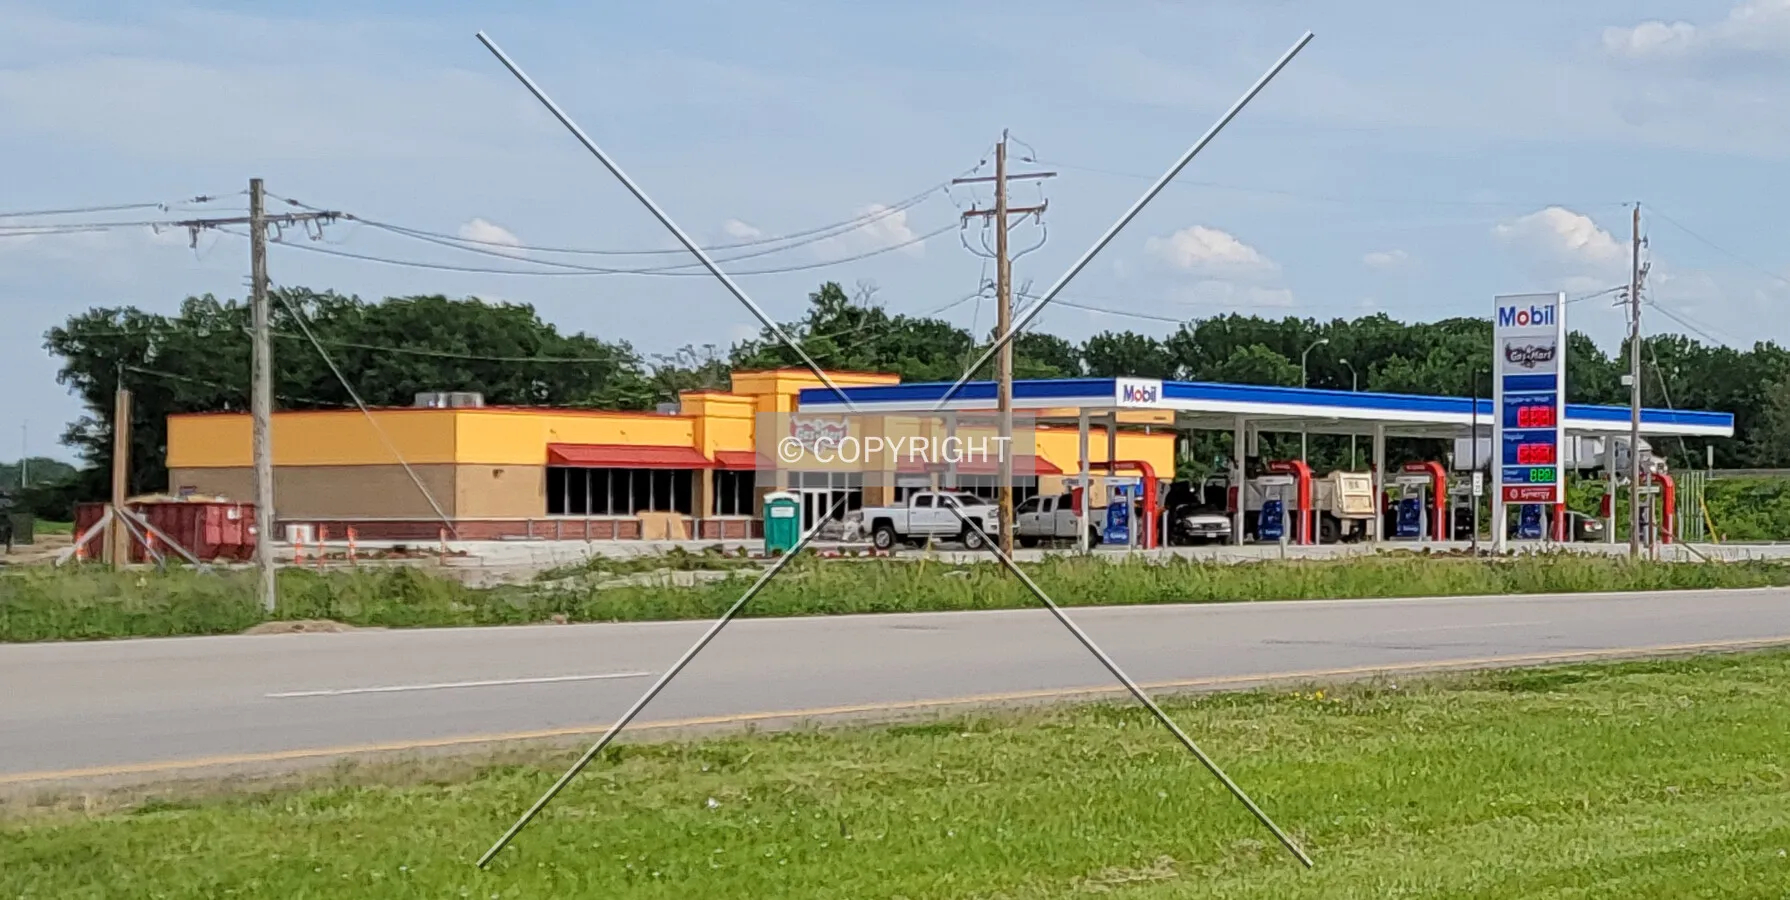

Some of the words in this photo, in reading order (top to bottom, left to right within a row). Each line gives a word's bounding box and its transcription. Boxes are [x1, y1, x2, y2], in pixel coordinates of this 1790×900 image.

[1499, 305, 1554, 327] Mobil
[1123, 384, 1157, 403] Mobil
[1520, 488, 1550, 500] Synergy
